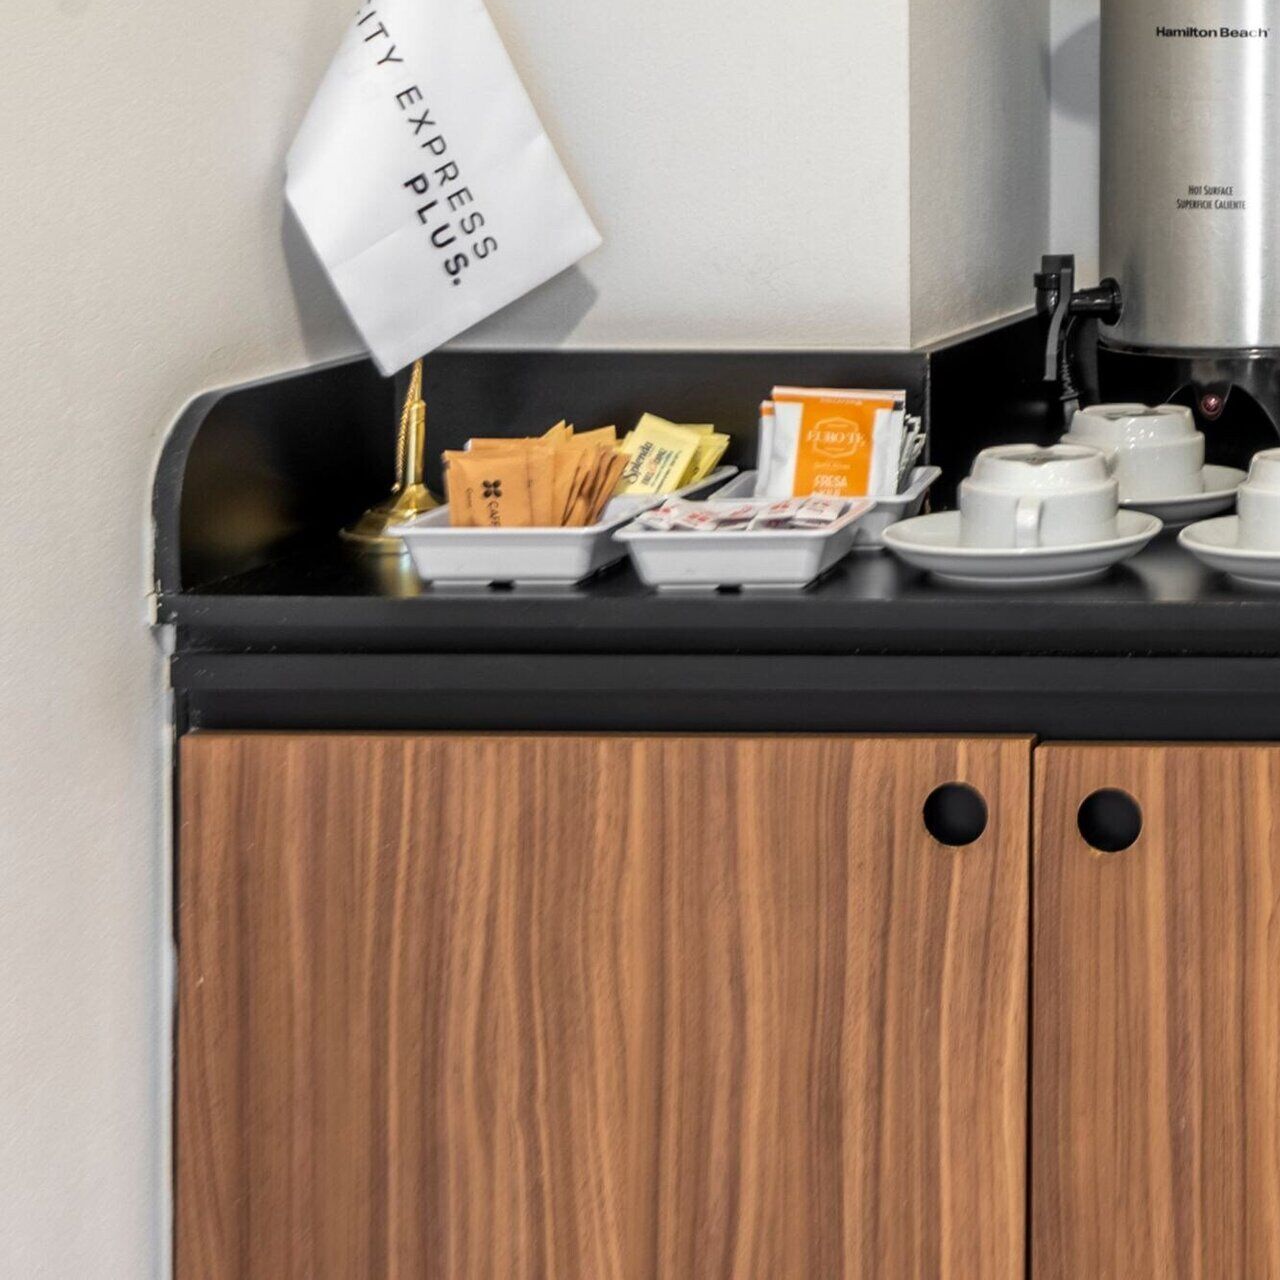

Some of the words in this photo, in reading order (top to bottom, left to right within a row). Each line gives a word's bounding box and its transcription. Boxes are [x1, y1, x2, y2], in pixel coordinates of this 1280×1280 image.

[1155, 26, 1218, 38] Hamilton
[1219, 27, 1268, 38] Beach
[394, 84, 499, 261] EXPRESS
[403, 172, 471, 286] PLUS.
[622, 441, 655, 485] Splenda
